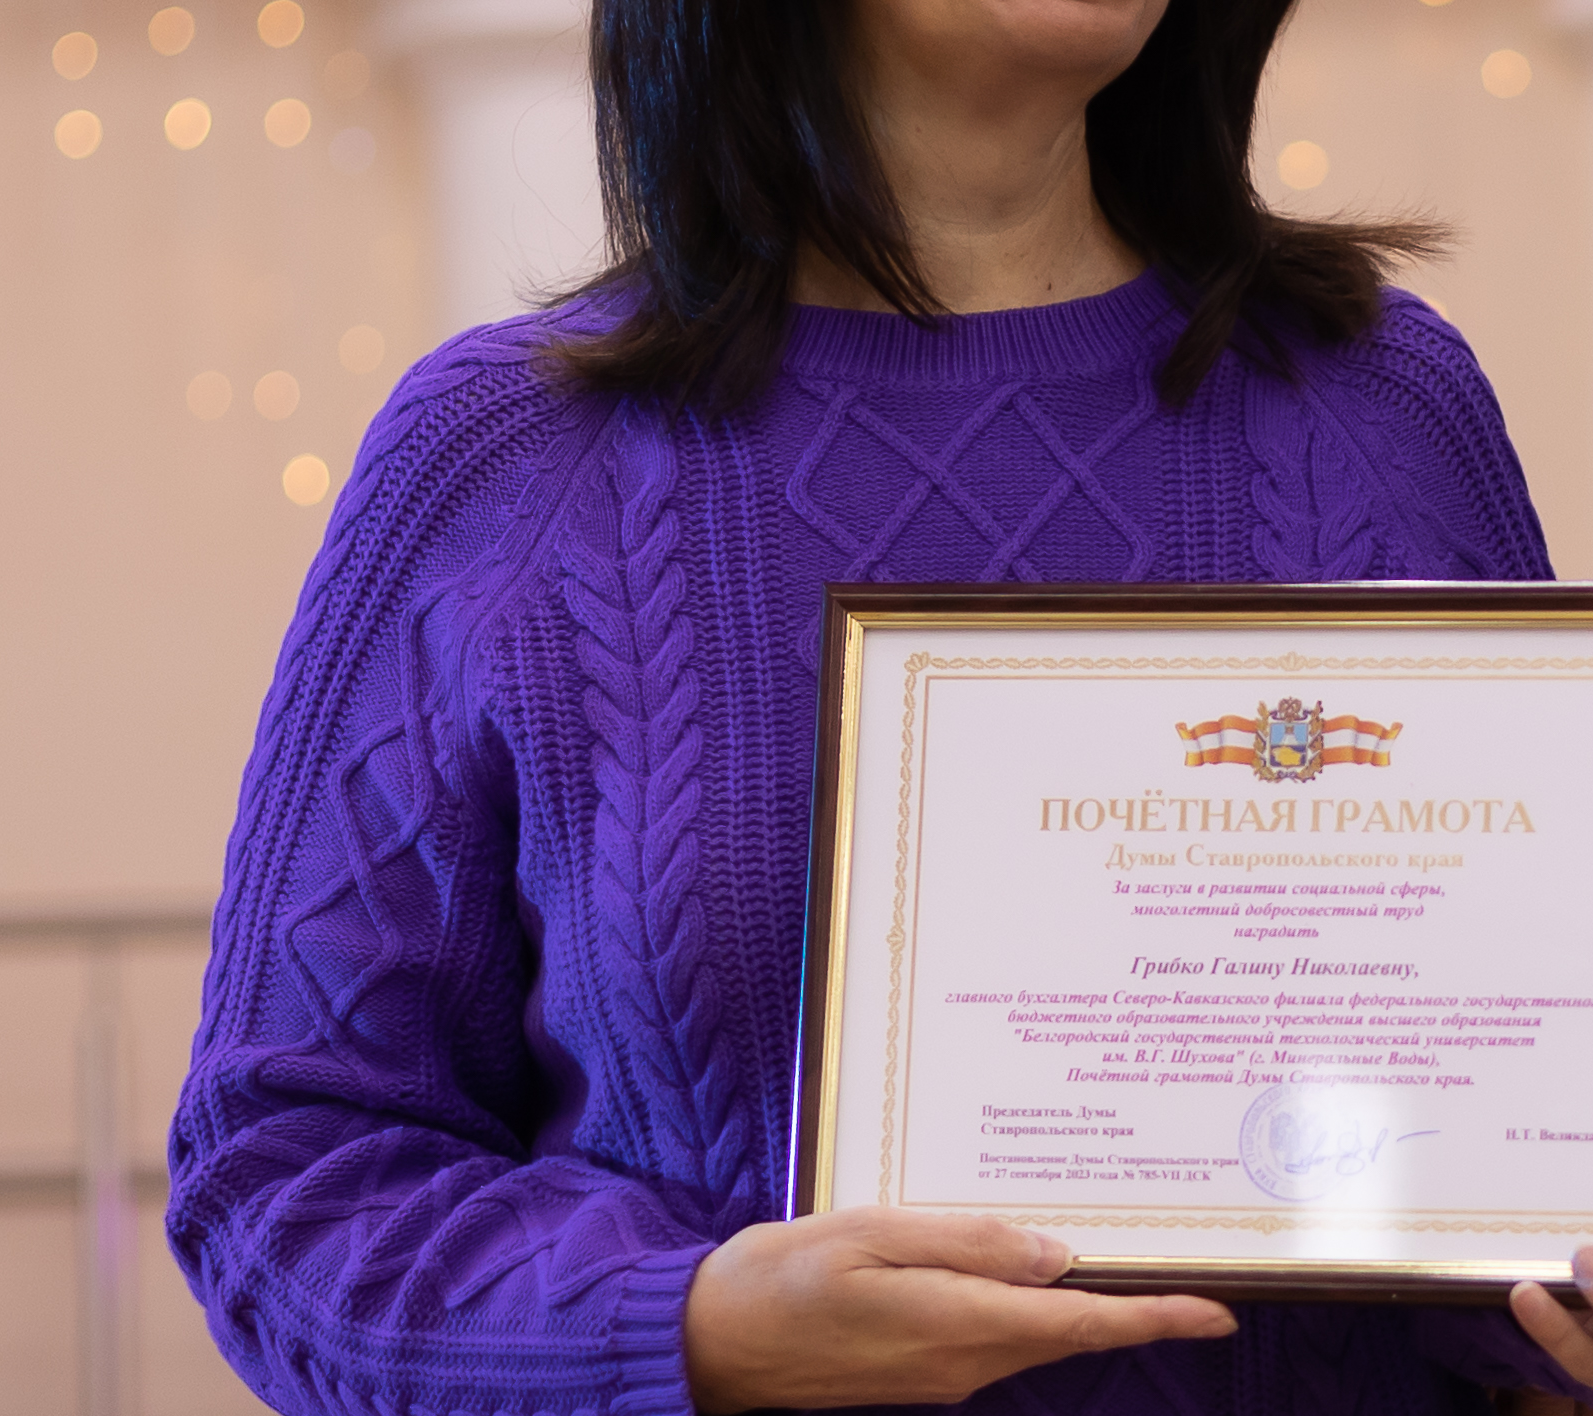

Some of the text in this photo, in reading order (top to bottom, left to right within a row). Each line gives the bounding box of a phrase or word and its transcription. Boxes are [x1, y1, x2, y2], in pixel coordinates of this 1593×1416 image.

[1040, 790, 1537, 833] ПОЧЁТНАЯ ГРАМОТА
[1105, 843, 1464, 873] Думы Ставропольского края
[1113, 880, 1446, 900] За заслуги в развитии социальной сферы,
[1130, 901, 1424, 921] многолетний добросовестный труд
[1234, 924, 1319, 940] наградить
[1130, 956, 1419, 981] Грибко Галину Николаевну,
[945, 992, 1013, 1006] главного
[1018, 990, 1107, 1007] бухгалтера
[1113, 990, 1269, 1007] Северо-Кавказского
[1274, 992, 1344, 1008] филиала
[1349, 992, 1458, 1009] федерального
[1008, 1009, 1542, 1029] бюджетного образовательного учреждения высшего образования
[1015, 1028, 1535, 1050] "Белгородский государственный технологический университет
[1102, 1049, 1440, 1067] им. В.Г. Шухова" (г. Минеральные Воды),
[1066, 1067, 1474, 1089] Почётной грамотой Думы Ставропольского края.
[982, 1105, 1116, 1120] Председатель Думы
[981, 1123, 1134, 1138] Ставропольского края
[979, 1153, 1239, 1167] Постановление Думы Ставропольского края
[979, 1170, 991, 1178] от
[994, 1168, 1007, 1179] 27
[1065, 1170, 1090, 1180] 2023
[1093, 1172, 1118, 1181] года
[1122, 1170, 1135, 1180] №
[1183, 1171, 1211, 1182] ДСК
